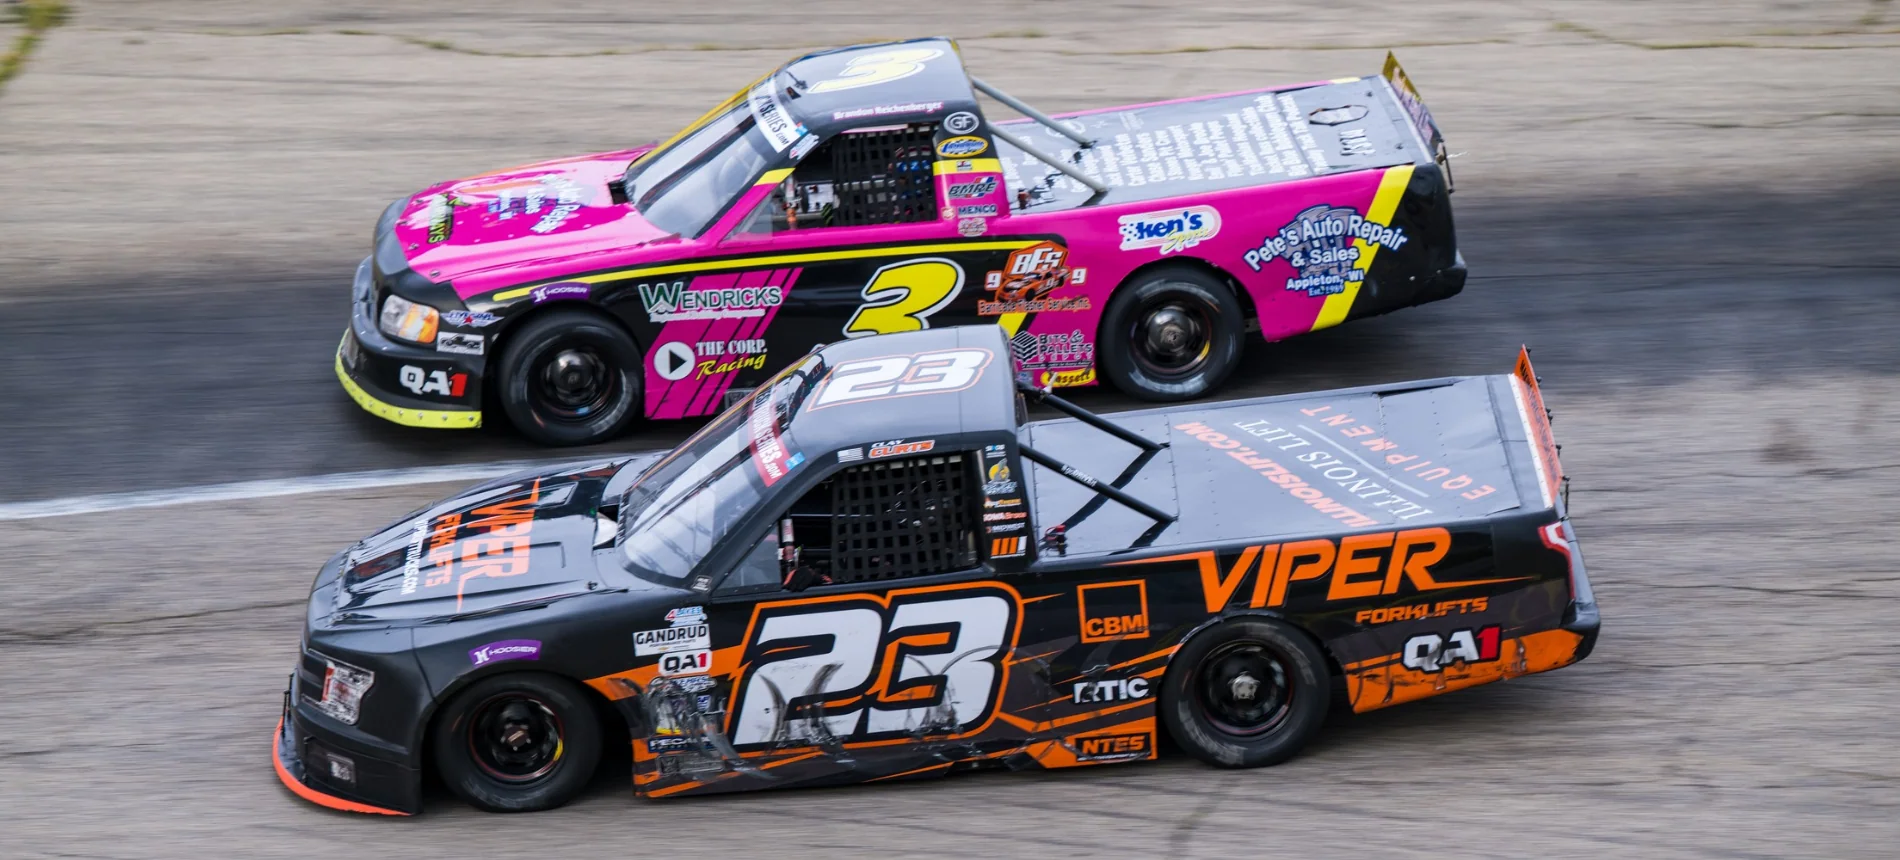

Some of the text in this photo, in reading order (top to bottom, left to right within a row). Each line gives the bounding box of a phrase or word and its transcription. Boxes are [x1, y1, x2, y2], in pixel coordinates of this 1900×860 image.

[806, 48, 945, 94] 3
[875, 101, 943, 116] Reichenberger
[953, 116, 971, 129] GF
[949, 182, 997, 196] BMRE
[958, 204, 997, 215] MENCO
[1136, 211, 1203, 240] ken's
[1244, 214, 1408, 272] Pete's Auto Repair
[1011, 248, 1063, 275] BFS
[1291, 245, 1360, 268] & Sales
[986, 272, 1001, 289] 9
[1071, 268, 1086, 284] 9
[1286, 269, 1364, 291] Appleton, WI
[546, 286, 588, 296] HOOSIER
[639, 282, 783, 313] WENDRICKS
[695, 339, 767, 356] THE CORP.
[1040, 335, 1067, 344] BITS
[1040, 344, 1093, 356] PALLETS
[696, 353, 767, 380] Racing
[1048, 371, 1091, 384] assett
[400, 365, 468, 397] QA1
[811, 350, 990, 408] 23
[870, 440, 935, 458] CURTS
[872, 439, 904, 448] CLAY
[1300, 405, 1496, 500] EQUIPMENT
[1234, 419, 1433, 520] ILLINOIS LIFT
[424, 513, 462, 588] FORKLIFTS
[459, 482, 540, 600] VIPER
[1196, 527, 1452, 614] VIPER
[1355, 597, 1489, 625] FORKLIFTS
[636, 625, 707, 645] GANDRUD
[1086, 615, 1145, 637] CBM
[489, 645, 537, 656] HOOSIER
[1403, 627, 1501, 673] QA1
[664, 652, 707, 672] QA1
[733, 594, 1012, 747] 23
[1074, 678, 1150, 704] RTIC
[1082, 736, 1145, 755] NTES
